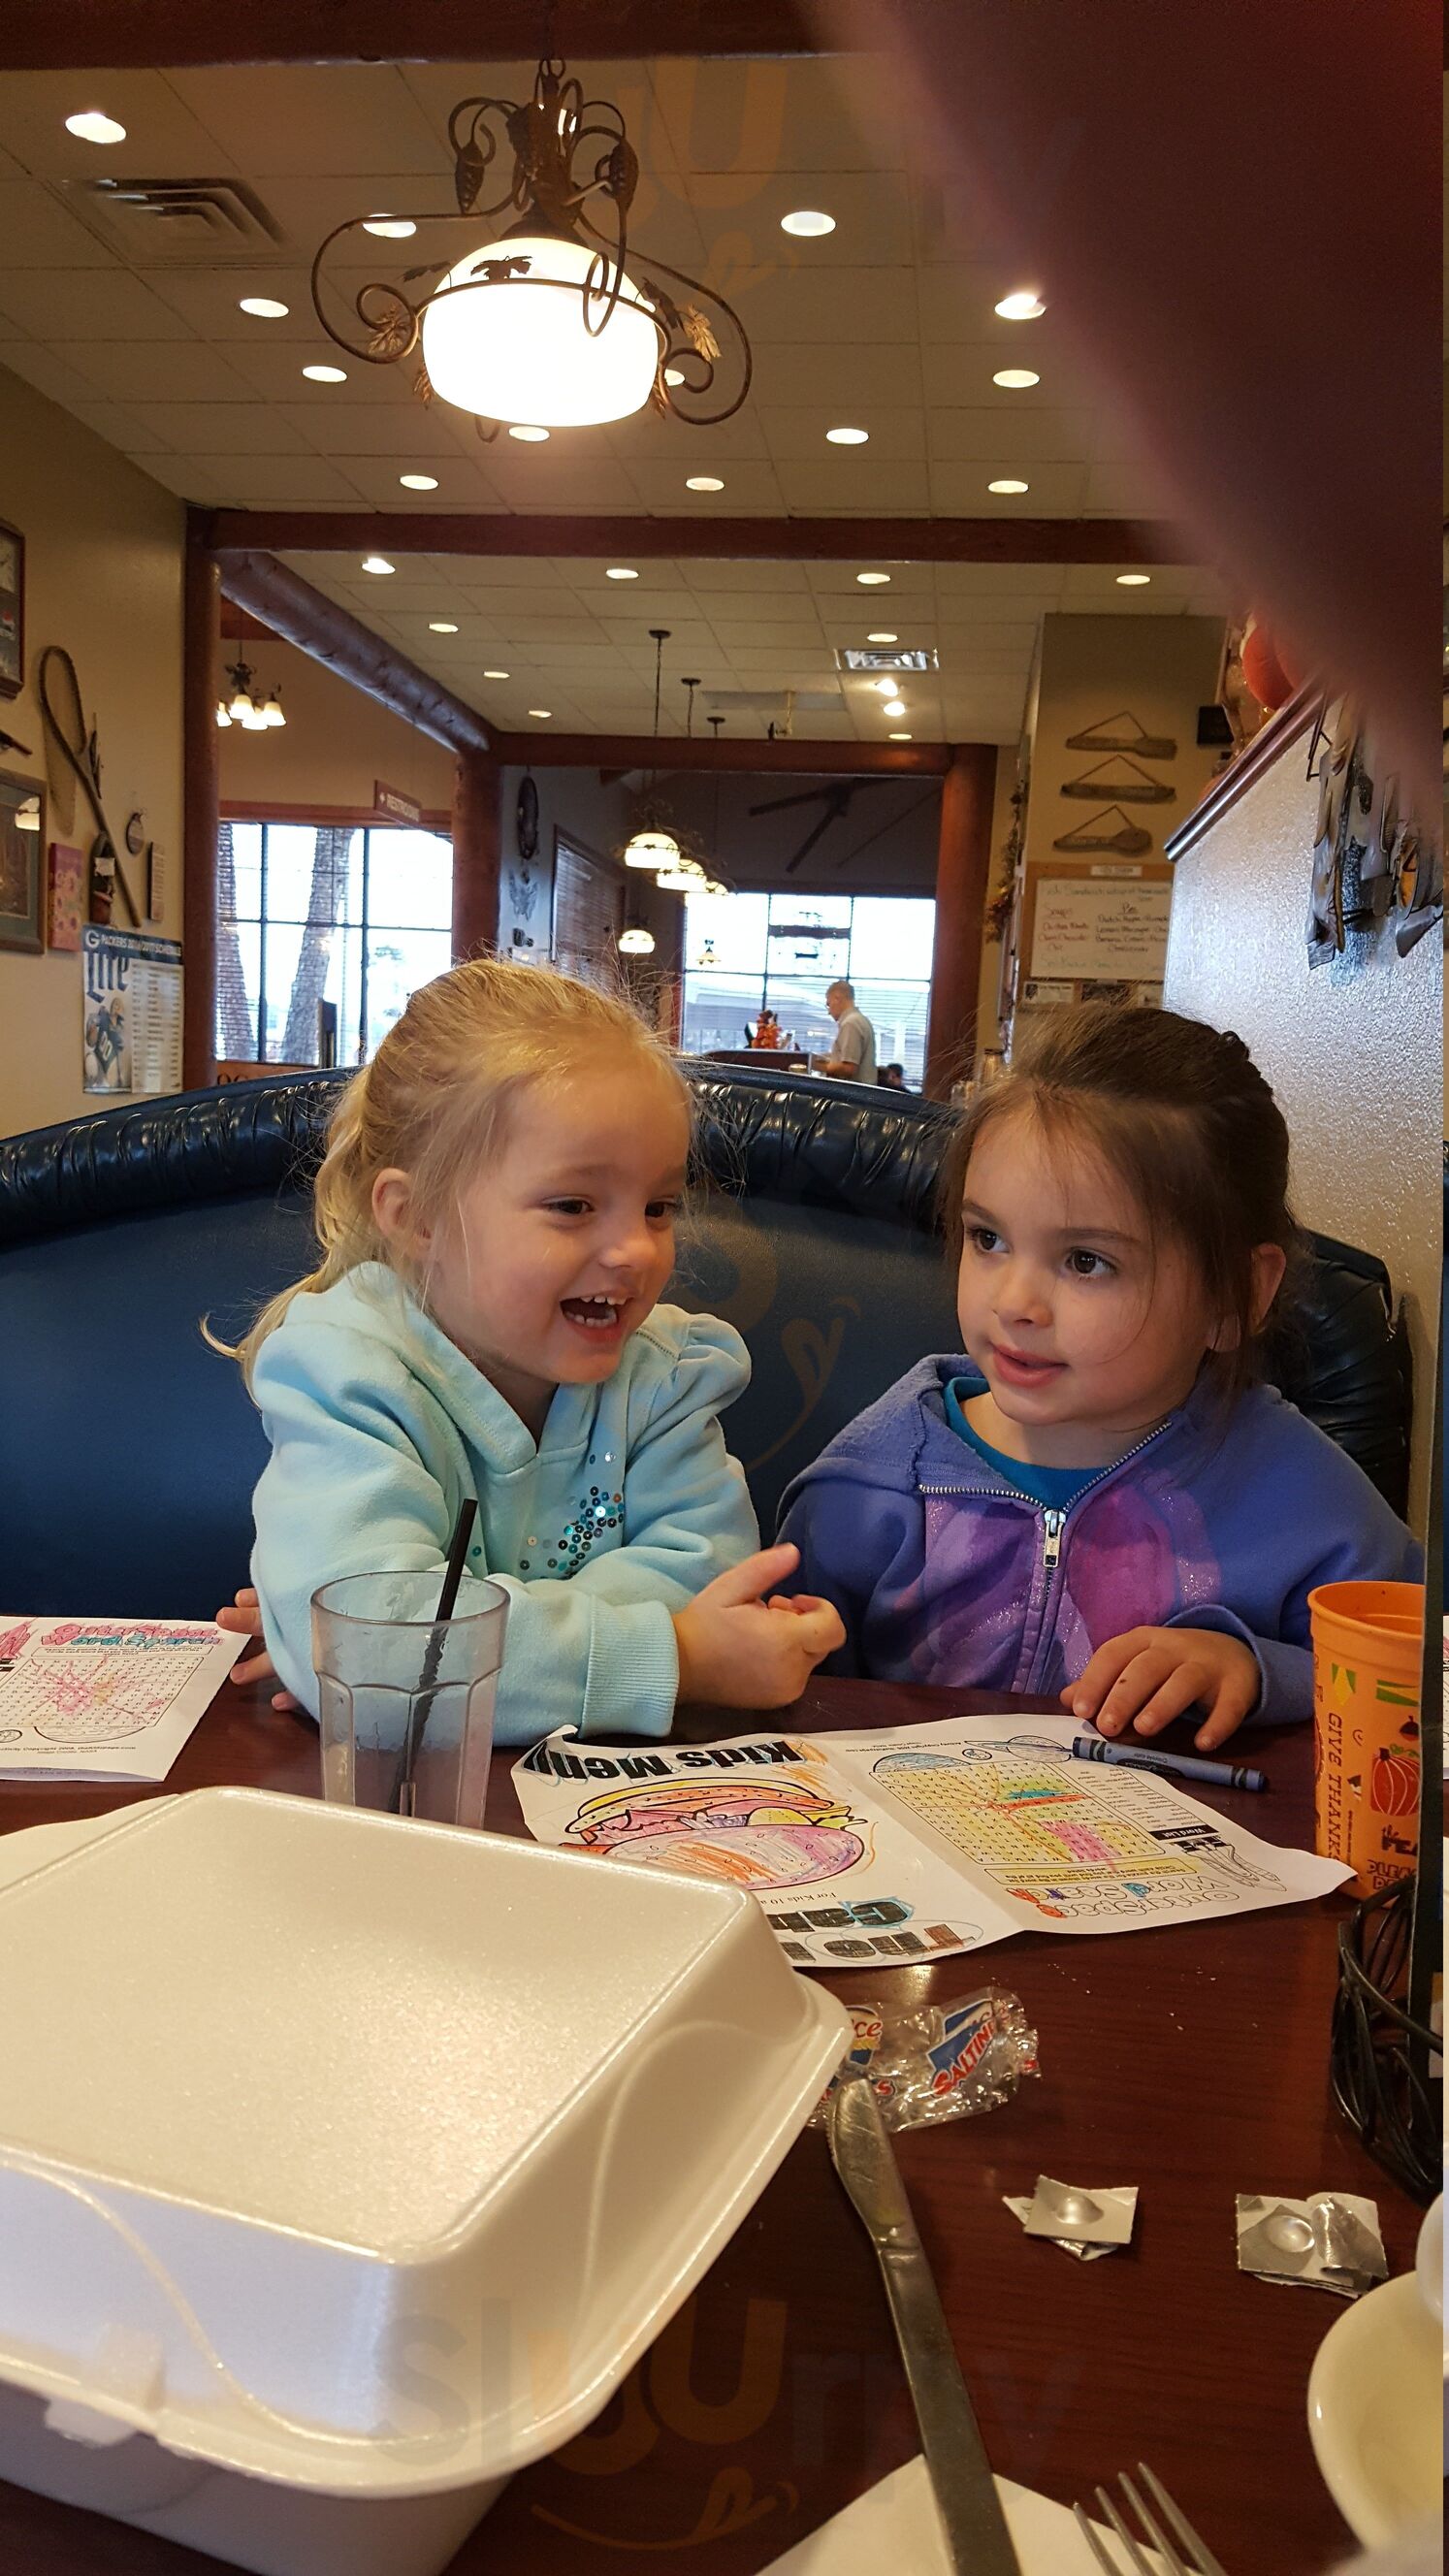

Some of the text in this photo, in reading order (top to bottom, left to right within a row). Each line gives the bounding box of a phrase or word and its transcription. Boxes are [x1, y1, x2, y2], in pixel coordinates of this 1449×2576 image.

[101, 934, 127, 948] PACKERS
[1328, 1712, 1343, 1766] GIVE
[676, 1741, 804, 1768] Kids
[1162, 1827, 1207, 1840] Word List
[787, 1894, 815, 1904] Kids
[1007, 1877, 1231, 1904] Word Search
[770, 1897, 785, 1906] 10
[823, 1924, 973, 1959] The
